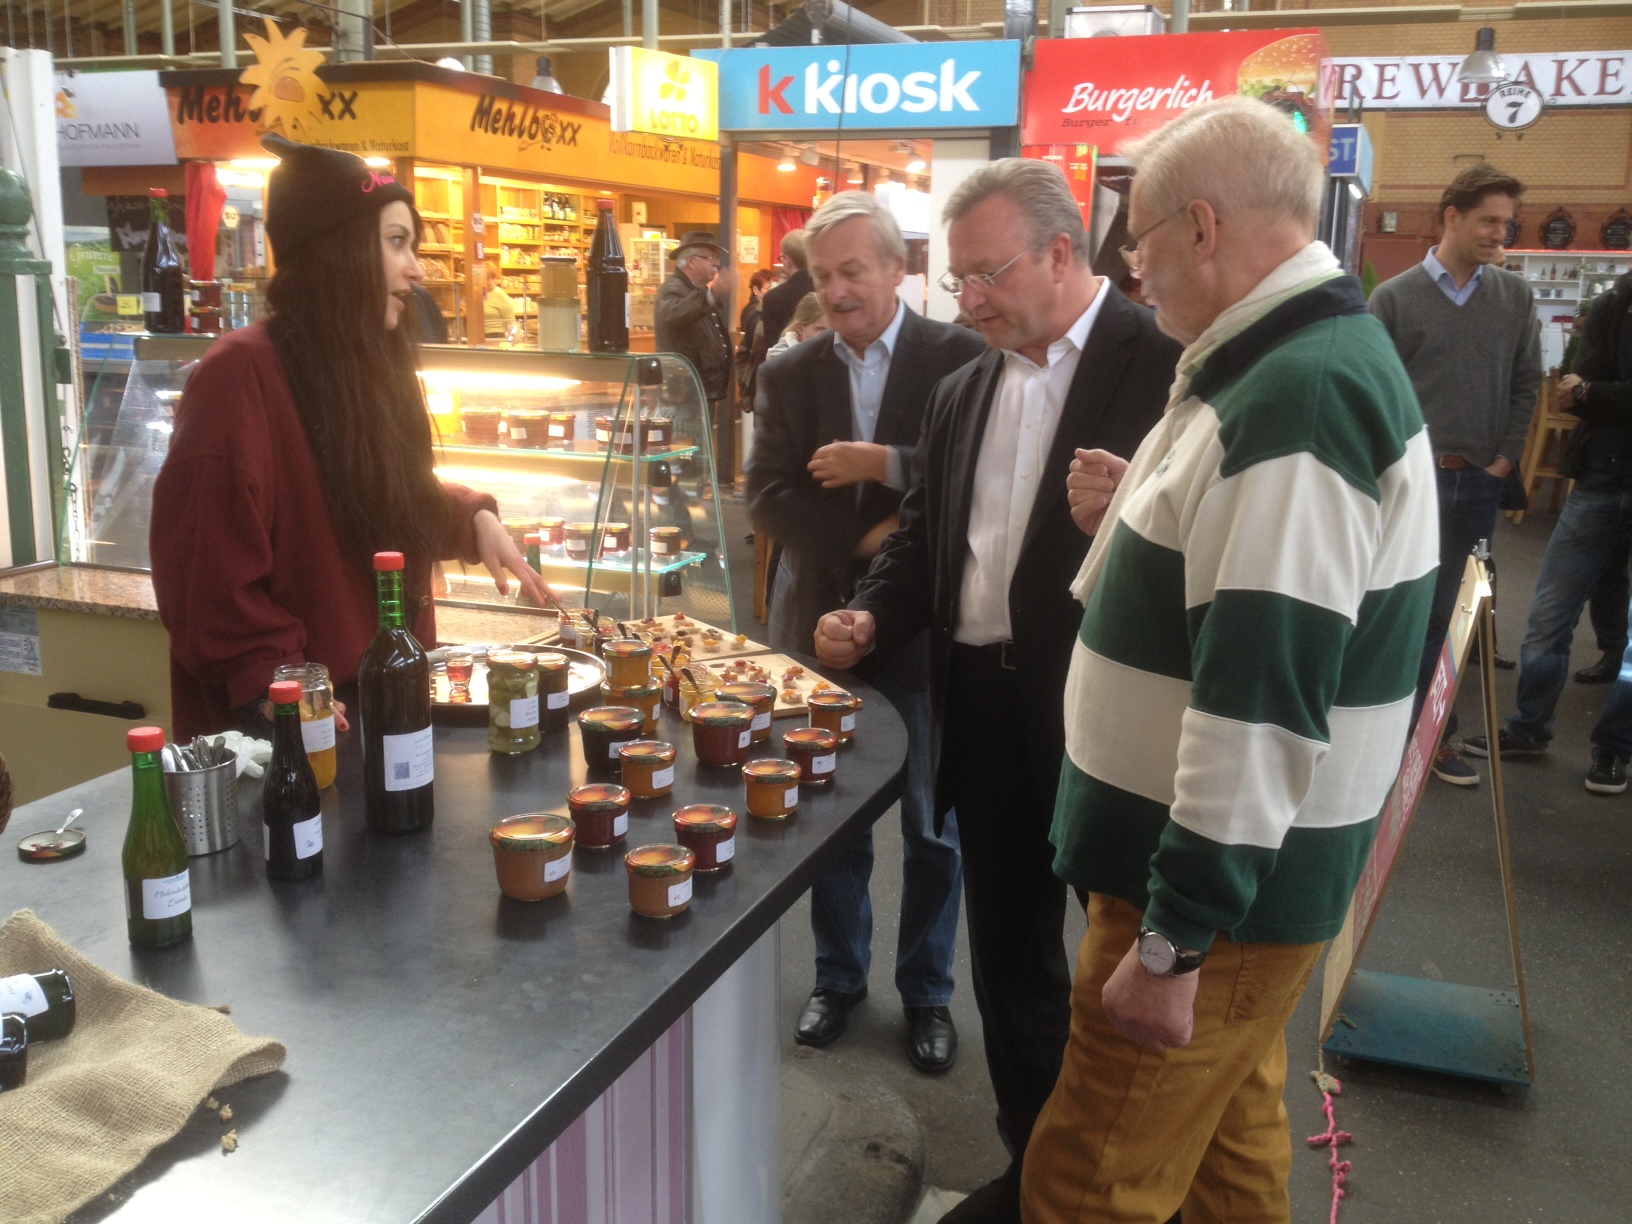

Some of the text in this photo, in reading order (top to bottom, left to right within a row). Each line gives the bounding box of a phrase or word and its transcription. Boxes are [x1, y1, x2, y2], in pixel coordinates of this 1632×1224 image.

[758, 58, 982, 115] k kiosk
[1061, 74, 1214, 122] Burgerlich
[1500, 87, 1532, 99] REIHE
[650, 109, 699, 134] LOTTO
[1061, 118, 1112, 128] Burger
[1506, 101, 1524, 124] 7
[57, 121, 140, 140] HOFMANN
[369, 138, 409, 152] Naturkost
[690, 146, 721, 171] Naturkos
